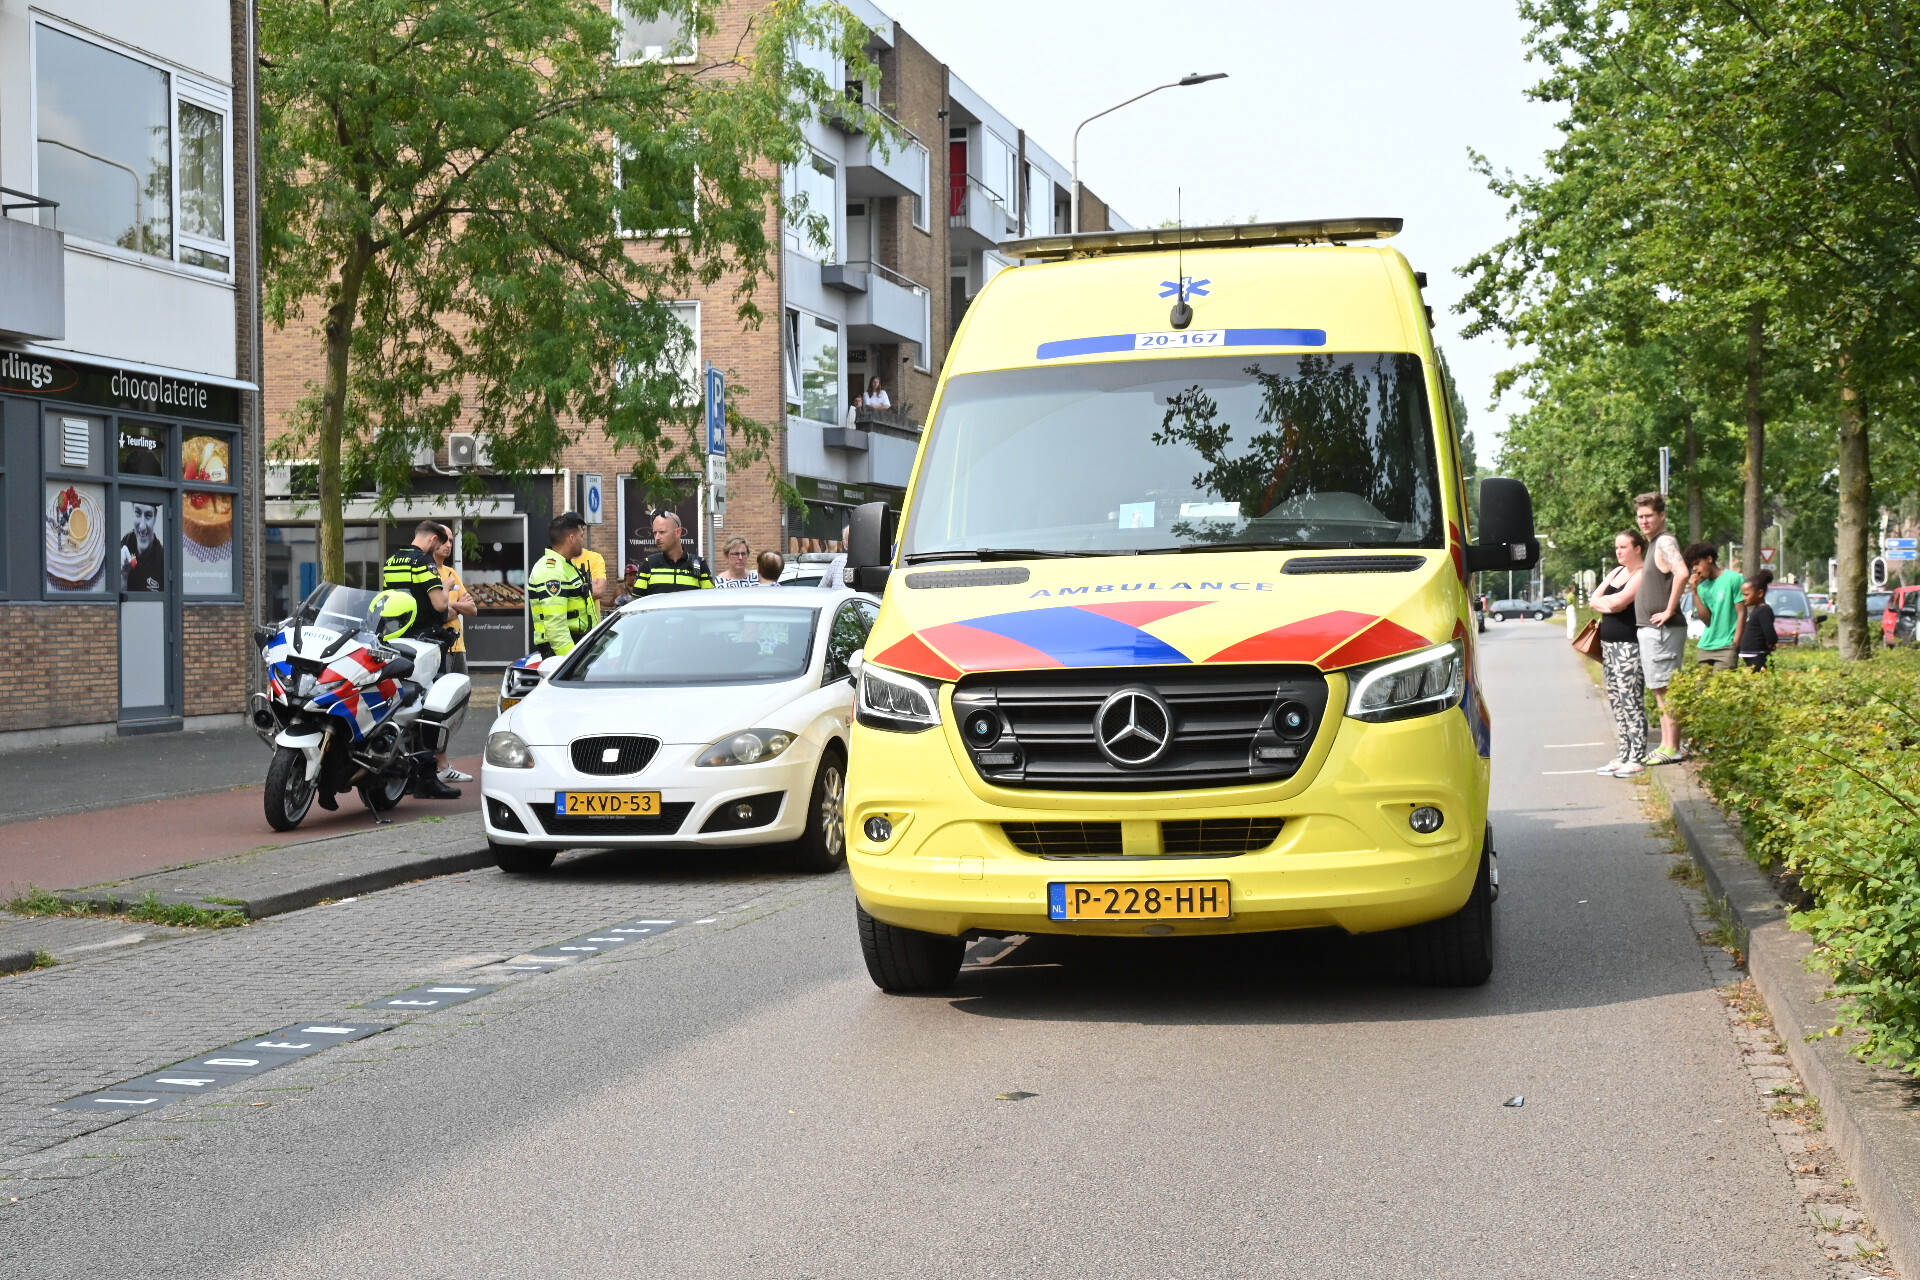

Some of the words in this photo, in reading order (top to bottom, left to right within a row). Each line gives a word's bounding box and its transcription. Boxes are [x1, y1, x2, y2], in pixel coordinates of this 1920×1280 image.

[1141, 331, 1219, 347] 20-167
[111, 370, 207, 409] chocolaterie
[126, 434, 157, 450] Teurlings
[1029, 580, 1274, 599] AMBULANCE
[304, 631, 333, 642] POLITIE
[569, 795, 651, 812] 2-KVD-53
[1052, 904, 1064, 913] NL
[1075, 886, 1217, 914] P-228-HH
[94, 1026, 356, 1104] LADEN
